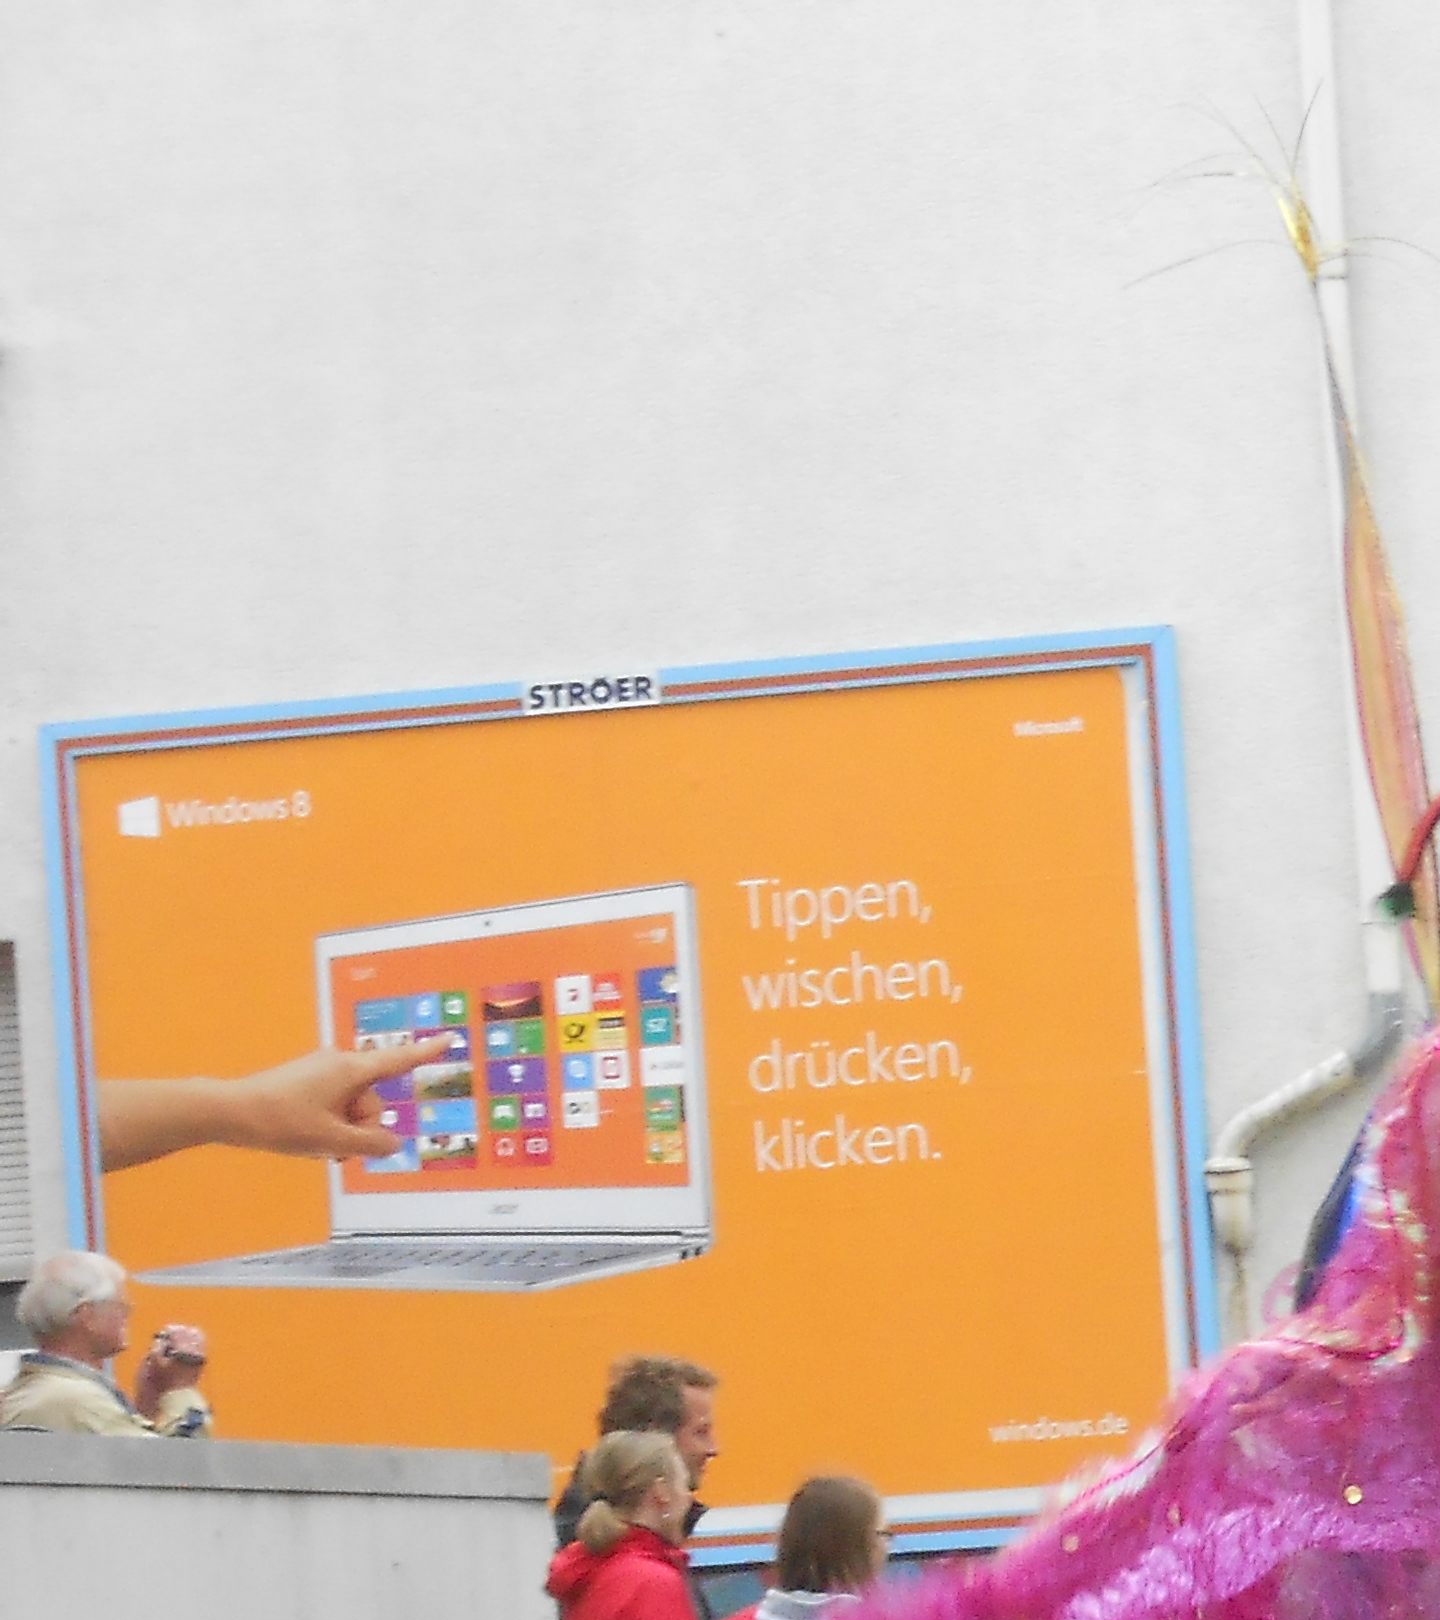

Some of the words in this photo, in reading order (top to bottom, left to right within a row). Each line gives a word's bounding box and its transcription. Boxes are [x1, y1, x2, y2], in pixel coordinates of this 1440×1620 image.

[530, 676, 652, 709] STRÖER
[165, 797, 289, 828] Windows
[292, 789, 312, 818] 8
[736, 878, 932, 941] Tippen,
[742, 950, 963, 1010] wischen,
[749, 1031, 973, 1092] drücken,
[754, 1113, 942, 1171] klicken.
[988, 1412, 1129, 1442] windows.de
